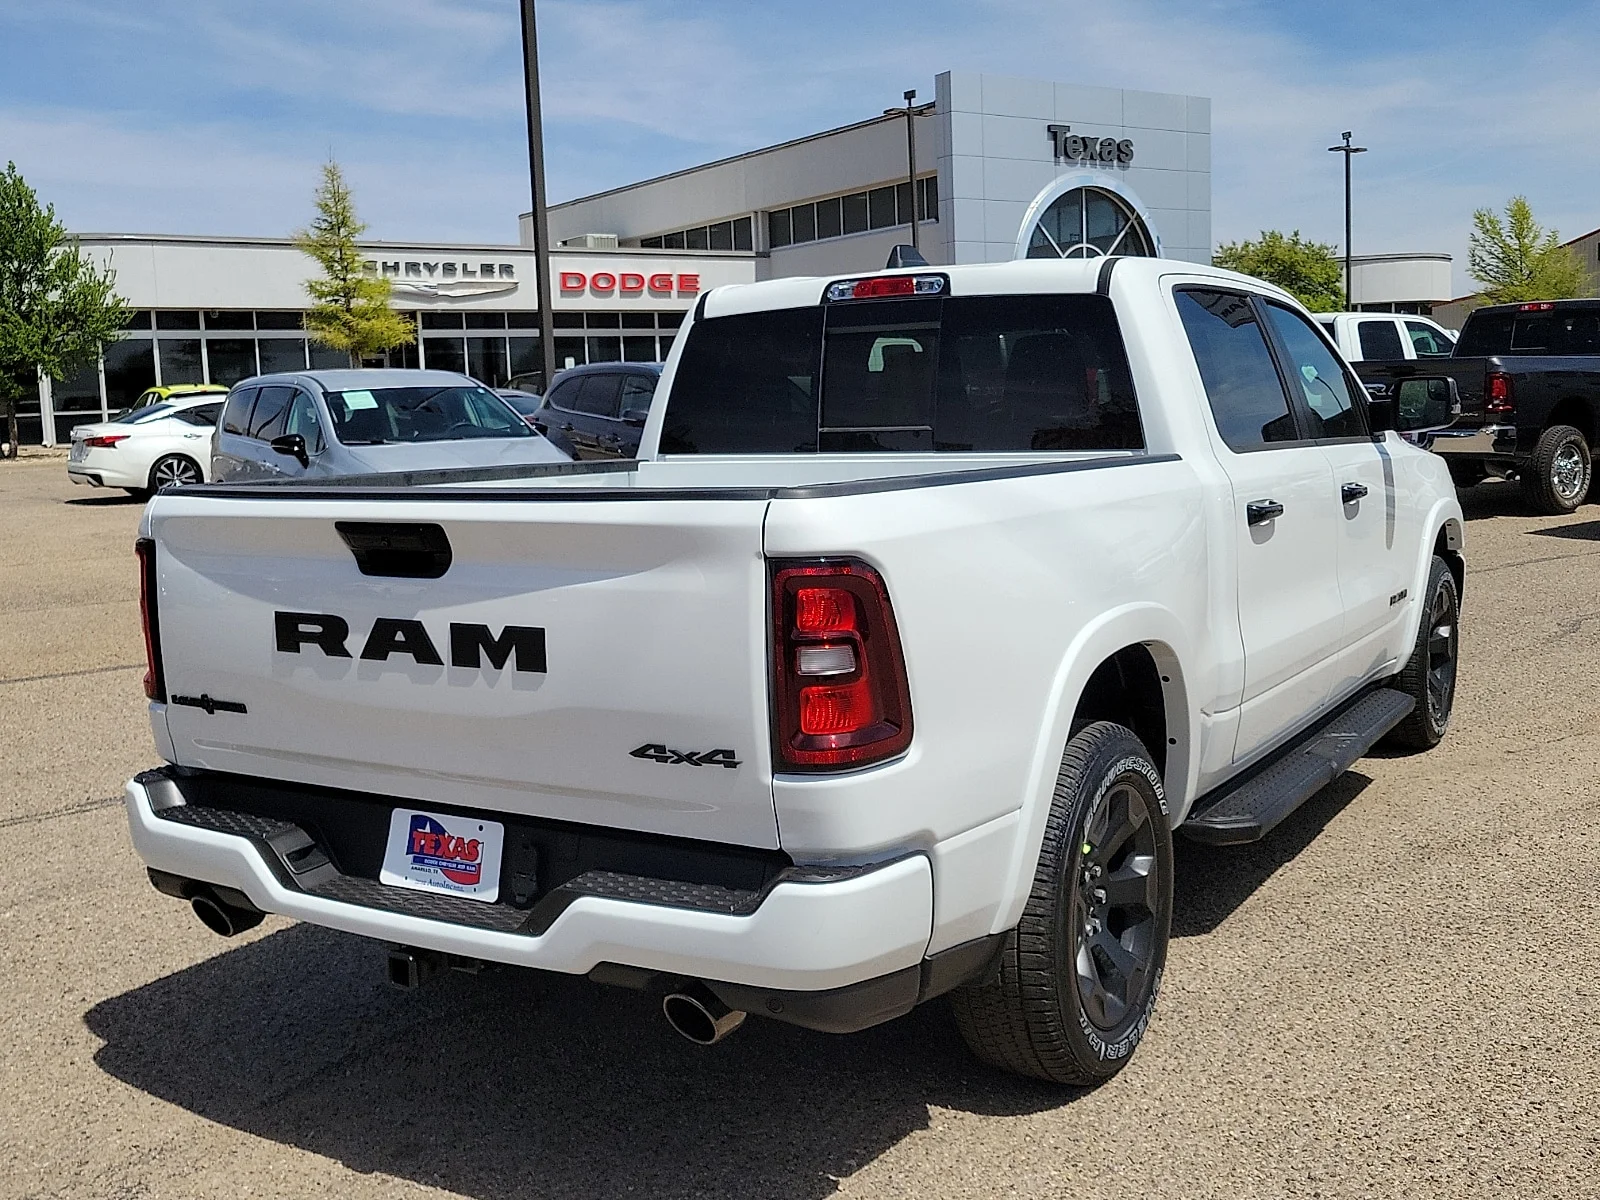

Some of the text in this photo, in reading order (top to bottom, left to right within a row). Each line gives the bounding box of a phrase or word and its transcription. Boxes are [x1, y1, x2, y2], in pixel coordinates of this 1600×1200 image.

[1047, 124, 1134, 163] Texas
[560, 272, 700, 292] DODGE
[274, 610, 548, 674] RAM
[412, 831, 479, 861] TEXAS
